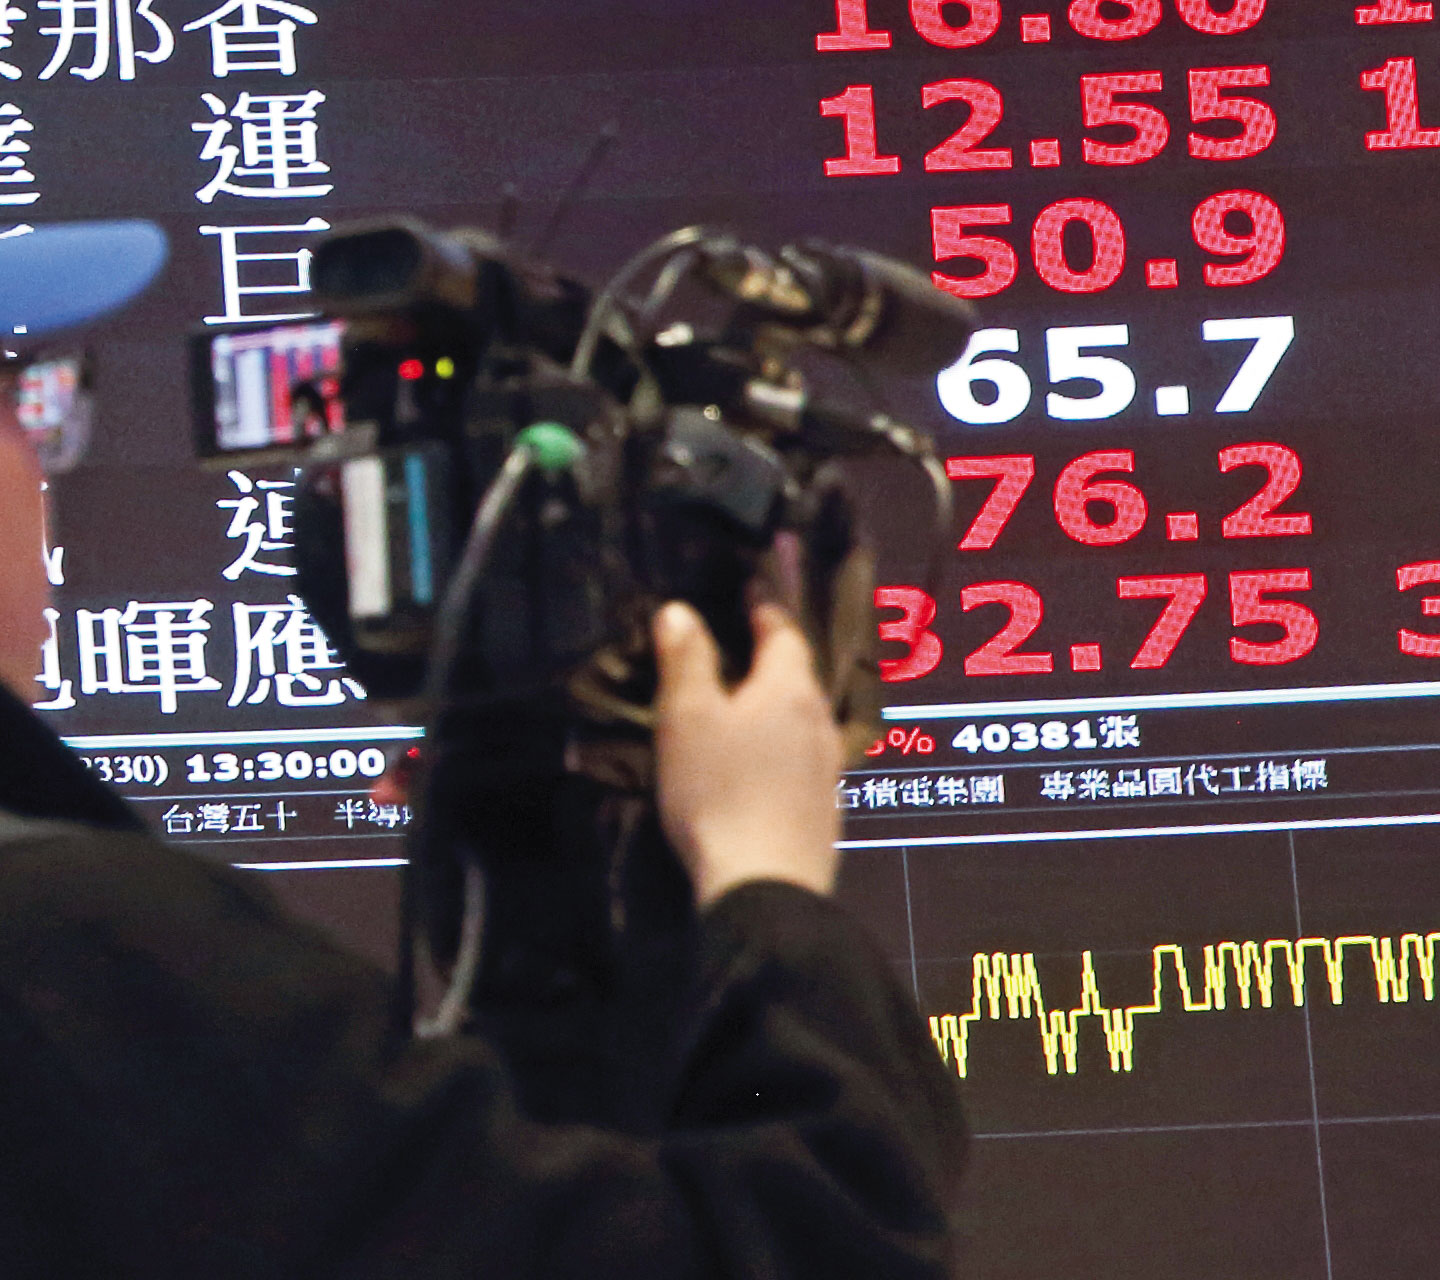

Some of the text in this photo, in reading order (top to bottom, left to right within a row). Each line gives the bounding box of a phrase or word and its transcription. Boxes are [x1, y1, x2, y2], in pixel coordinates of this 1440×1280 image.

[192, 90, 334, 203] 運
[819, 64, 1277, 177] 12.55
[926, 189, 1286, 302] 50.9
[937, 316, 1294, 424] 65.7
[873, 567, 1319, 683] 32.75
[186, 748, 385, 782] 13:30:00
